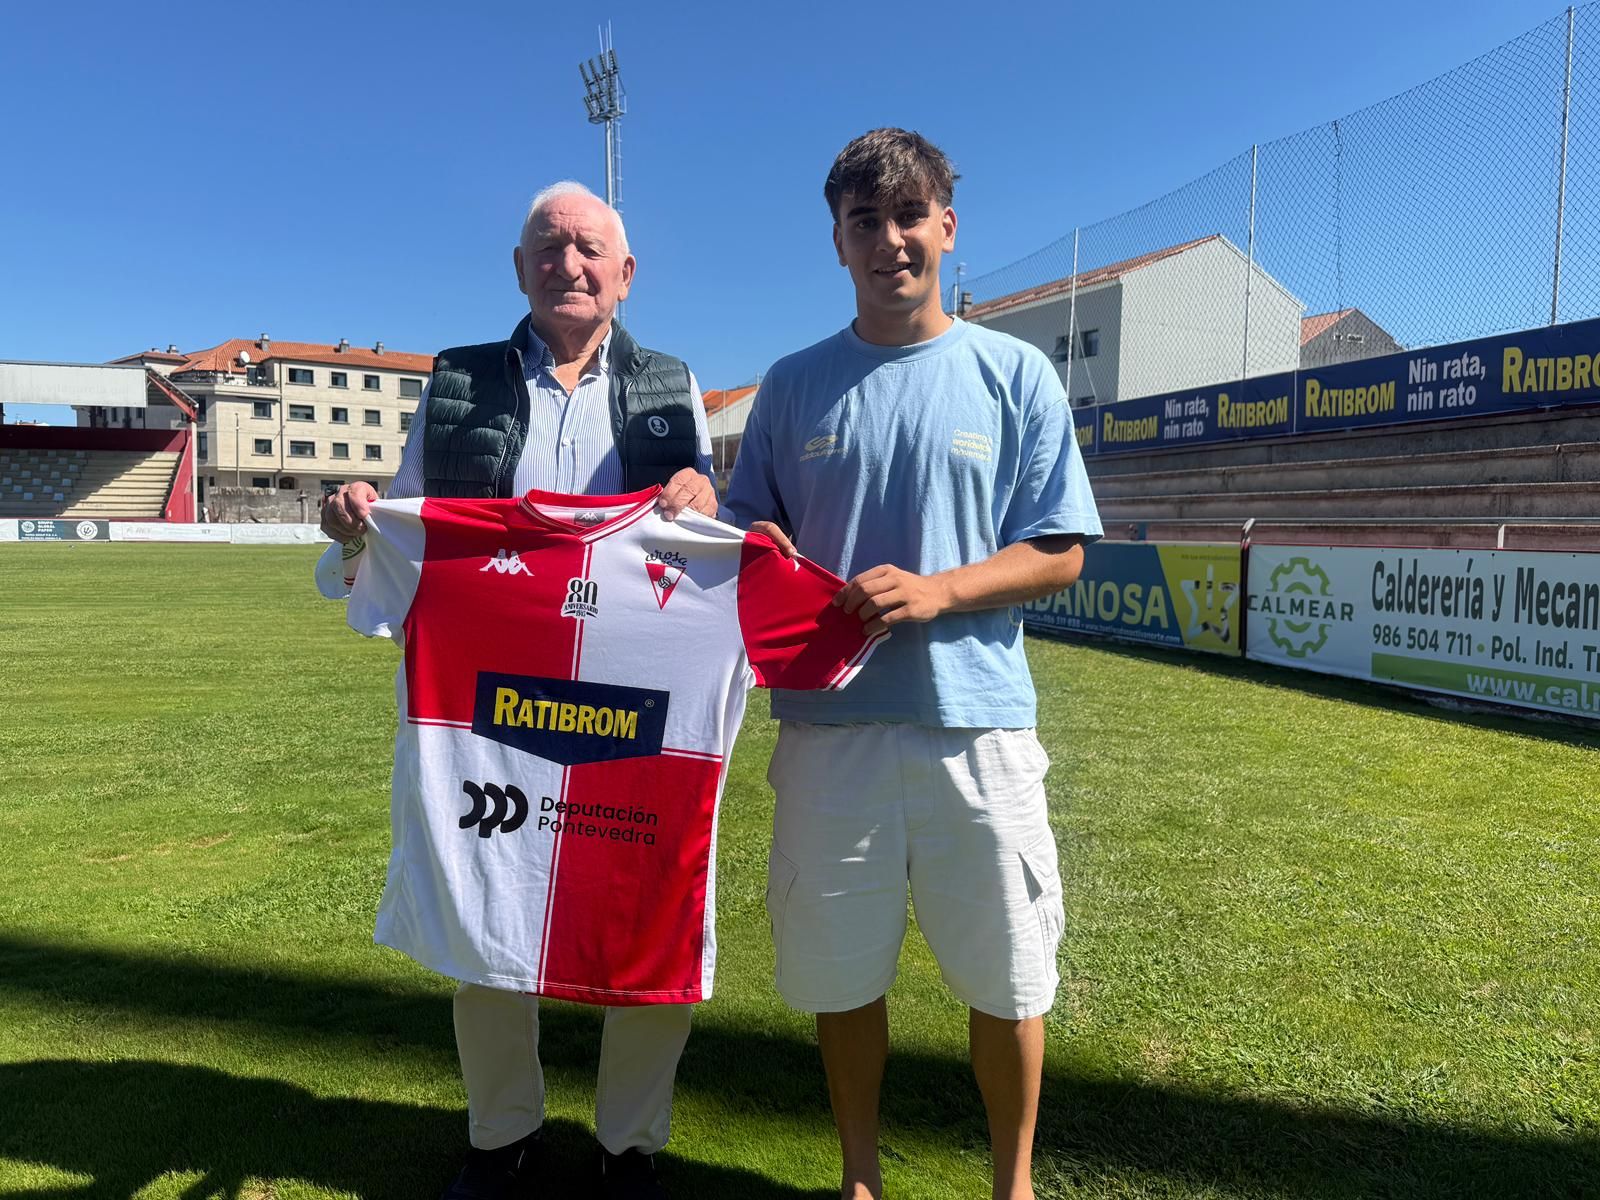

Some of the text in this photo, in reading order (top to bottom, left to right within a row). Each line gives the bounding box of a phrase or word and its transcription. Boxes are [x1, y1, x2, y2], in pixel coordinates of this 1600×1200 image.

[1408, 351, 1486, 385] Nin rata,
[1164, 396, 1209, 419] Nin rata,
[1217, 393, 1288, 428] RATIBROM
[1305, 378, 1396, 417] RATIBROM
[1407, 382, 1477, 413] nin rato
[1103, 412, 1159, 442] RATIBROM
[1163, 419, 1204, 440] nin rato
[568, 579, 598, 606] 80
[1371, 557, 1600, 631] Calderería y Mecan
[564, 602, 599, 614] ANIVERSARIO
[1247, 594, 1355, 622] CALMEAR
[1373, 623, 1401, 647] 986
[1406, 626, 1439, 652] 504
[1446, 630, 1472, 657] 711
[1491, 635, 1527, 664] Pol.
[1535, 639, 1574, 670] Ind.
[493, 686, 638, 740] RATIBROM
[540, 796, 658, 826] Deputación
[537, 816, 656, 846] Pontevedra
